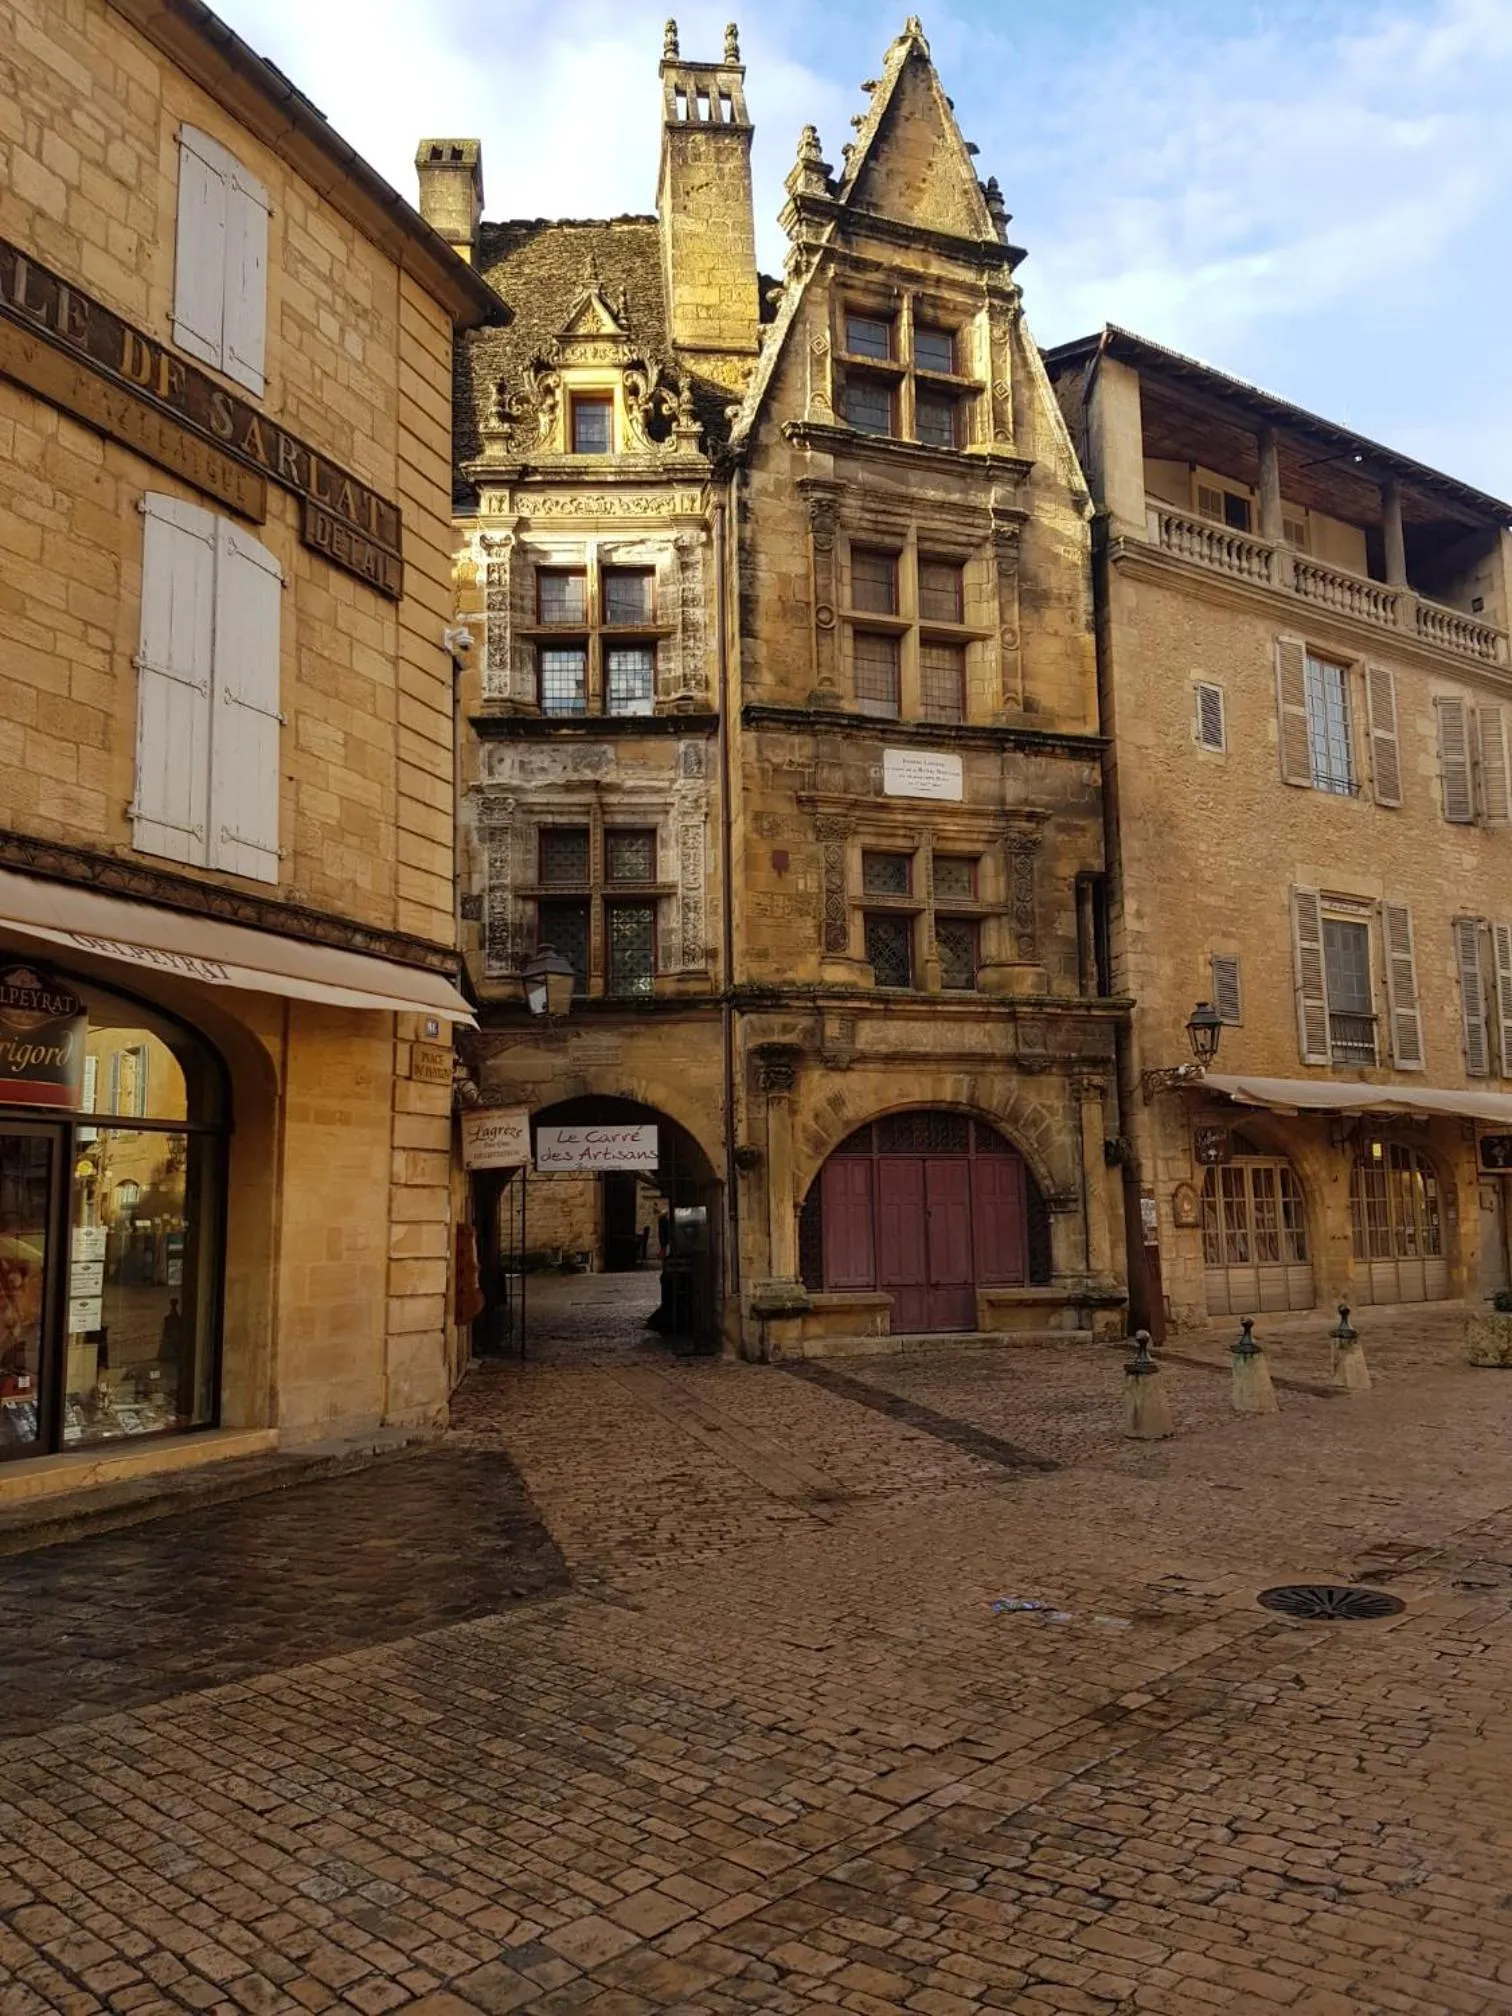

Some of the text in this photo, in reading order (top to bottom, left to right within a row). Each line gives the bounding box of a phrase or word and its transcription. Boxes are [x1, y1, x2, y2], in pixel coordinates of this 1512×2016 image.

[0, 255, 89, 350] LE
[209, 391, 387, 537] SARLAT
[69, 933, 231, 982] DELPEYRAT
[557, 1125, 642, 1144] Le Carré
[541, 1147, 659, 1162] des Artisans
